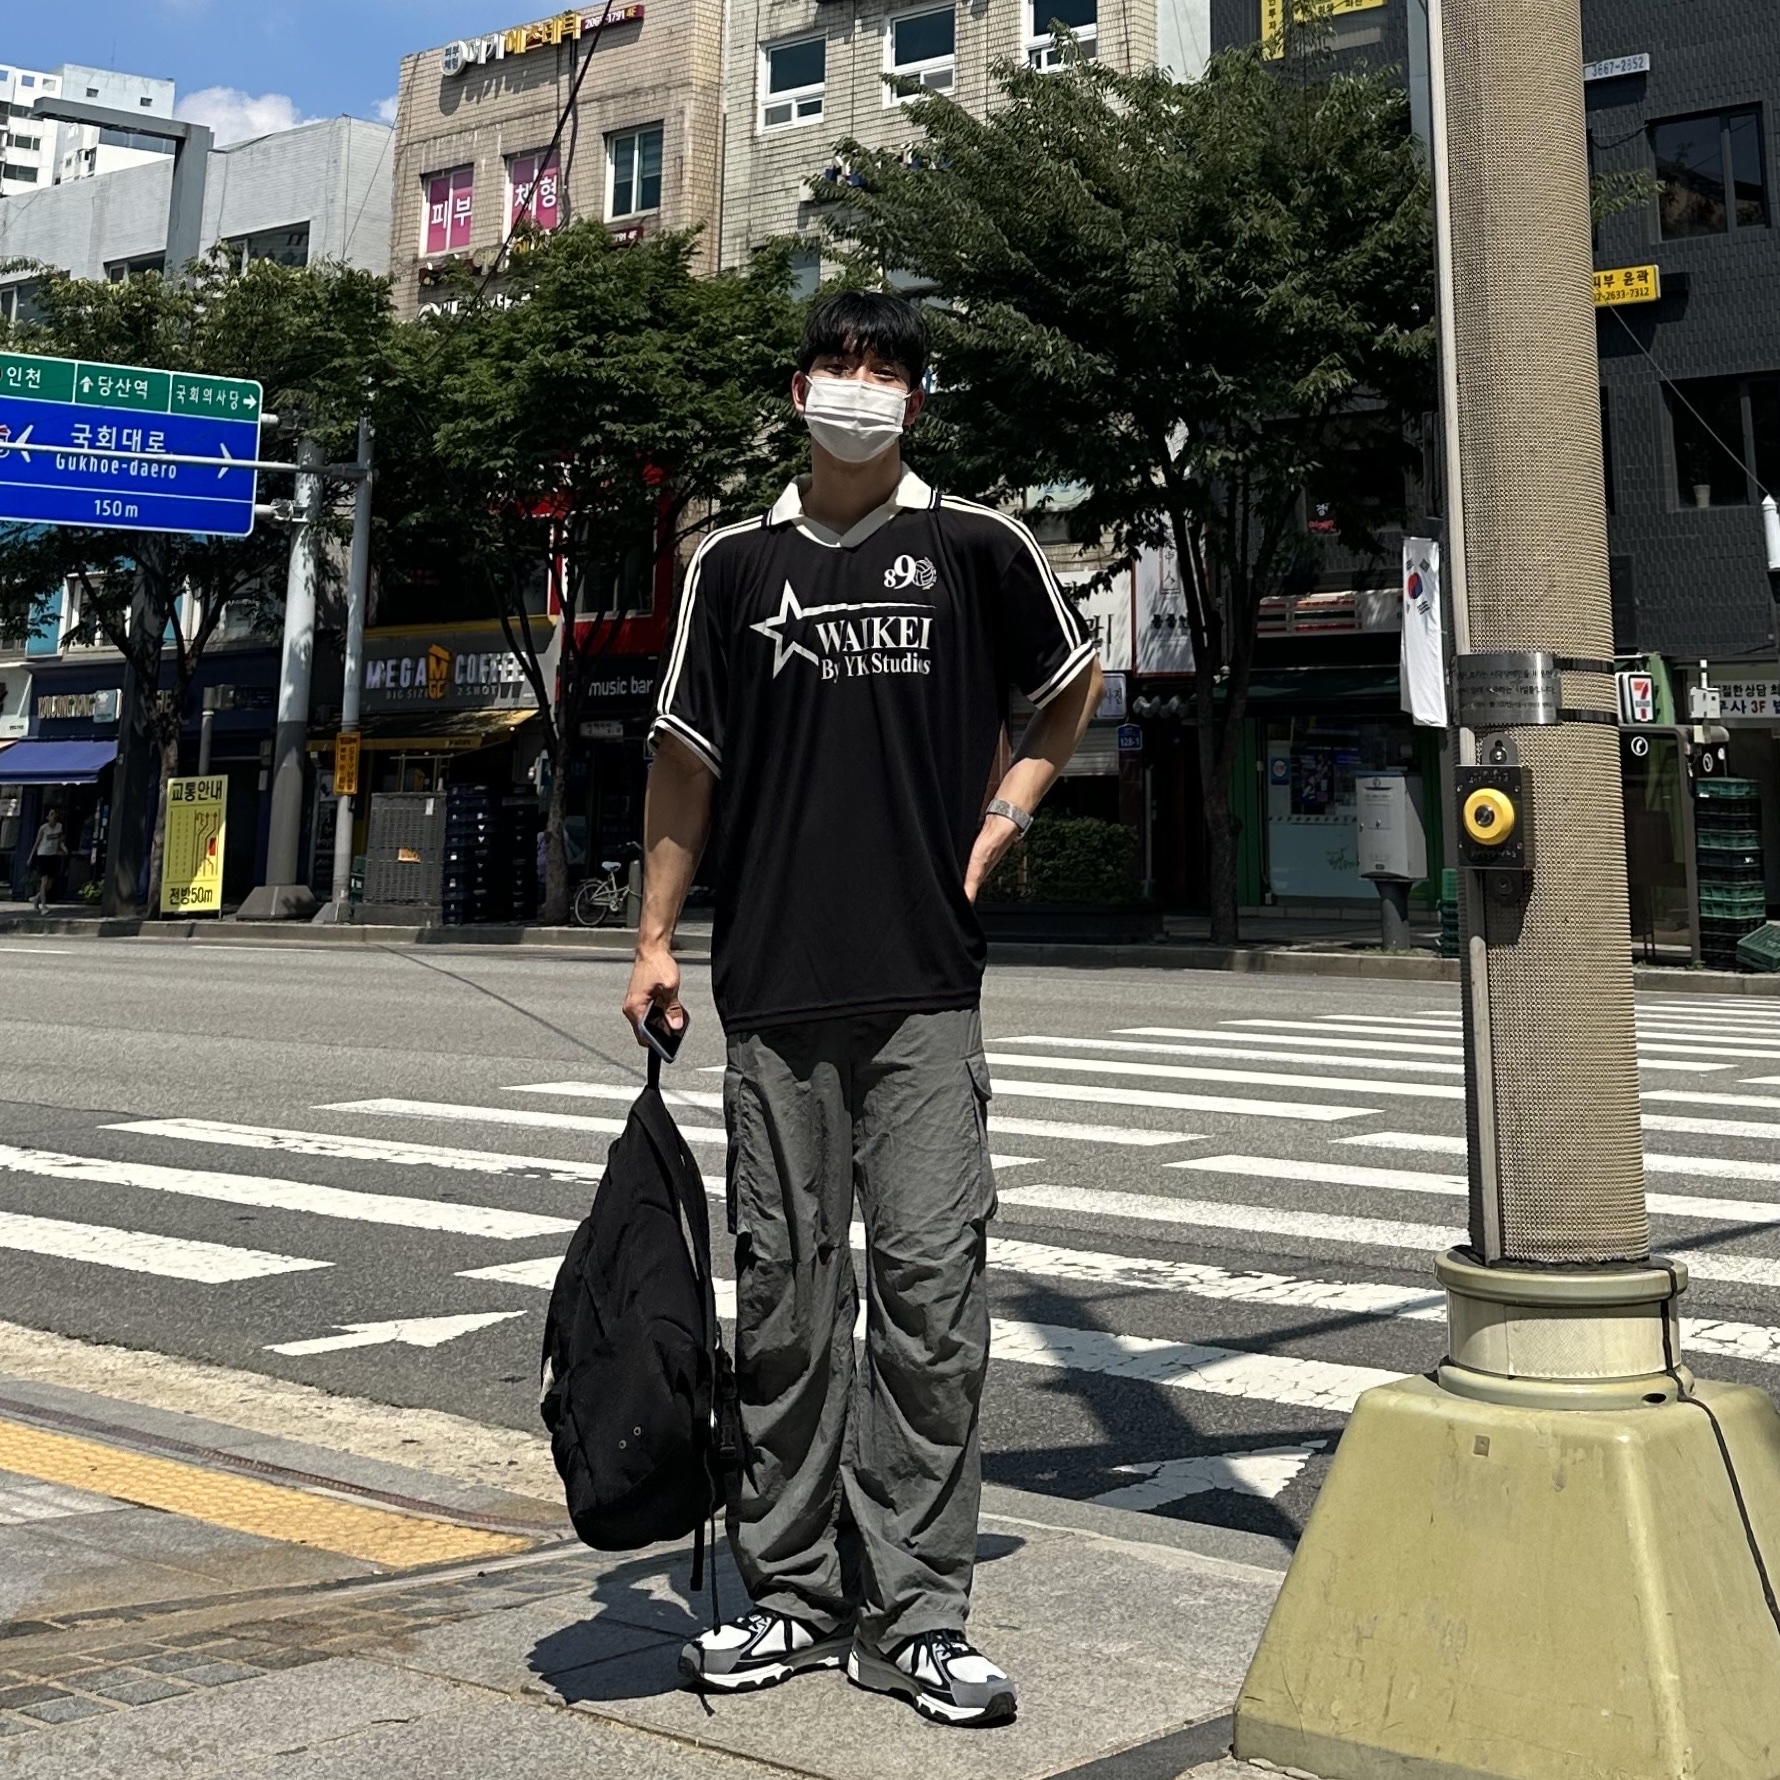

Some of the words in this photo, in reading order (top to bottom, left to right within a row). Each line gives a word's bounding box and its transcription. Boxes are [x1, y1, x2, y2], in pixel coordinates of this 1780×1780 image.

[431, 196, 472, 228] 피부
[1623, 269, 1649, 286] 윤곽
[7, 366, 41, 389] 인천
[98, 376, 148, 400] 당산역
[176, 384, 240, 411] 국회의사당
[70, 423, 167, 453] 국회대로
[56, 453, 177, 479] Gukhoe-daero
[815, 616, 933, 655] WAIKEI
[365, 656, 427, 689] MEGA
[455, 651, 527, 685] COFFEE
[821, 658, 840, 684] By
[844, 654, 870, 677] YK
[588, 676, 627, 697] music
[631, 675, 654, 694] bar
[1719, 684, 1767, 698] 절한상담
[1751, 700, 1767, 713] 3F
[171, 780, 223, 802] 교통안내
